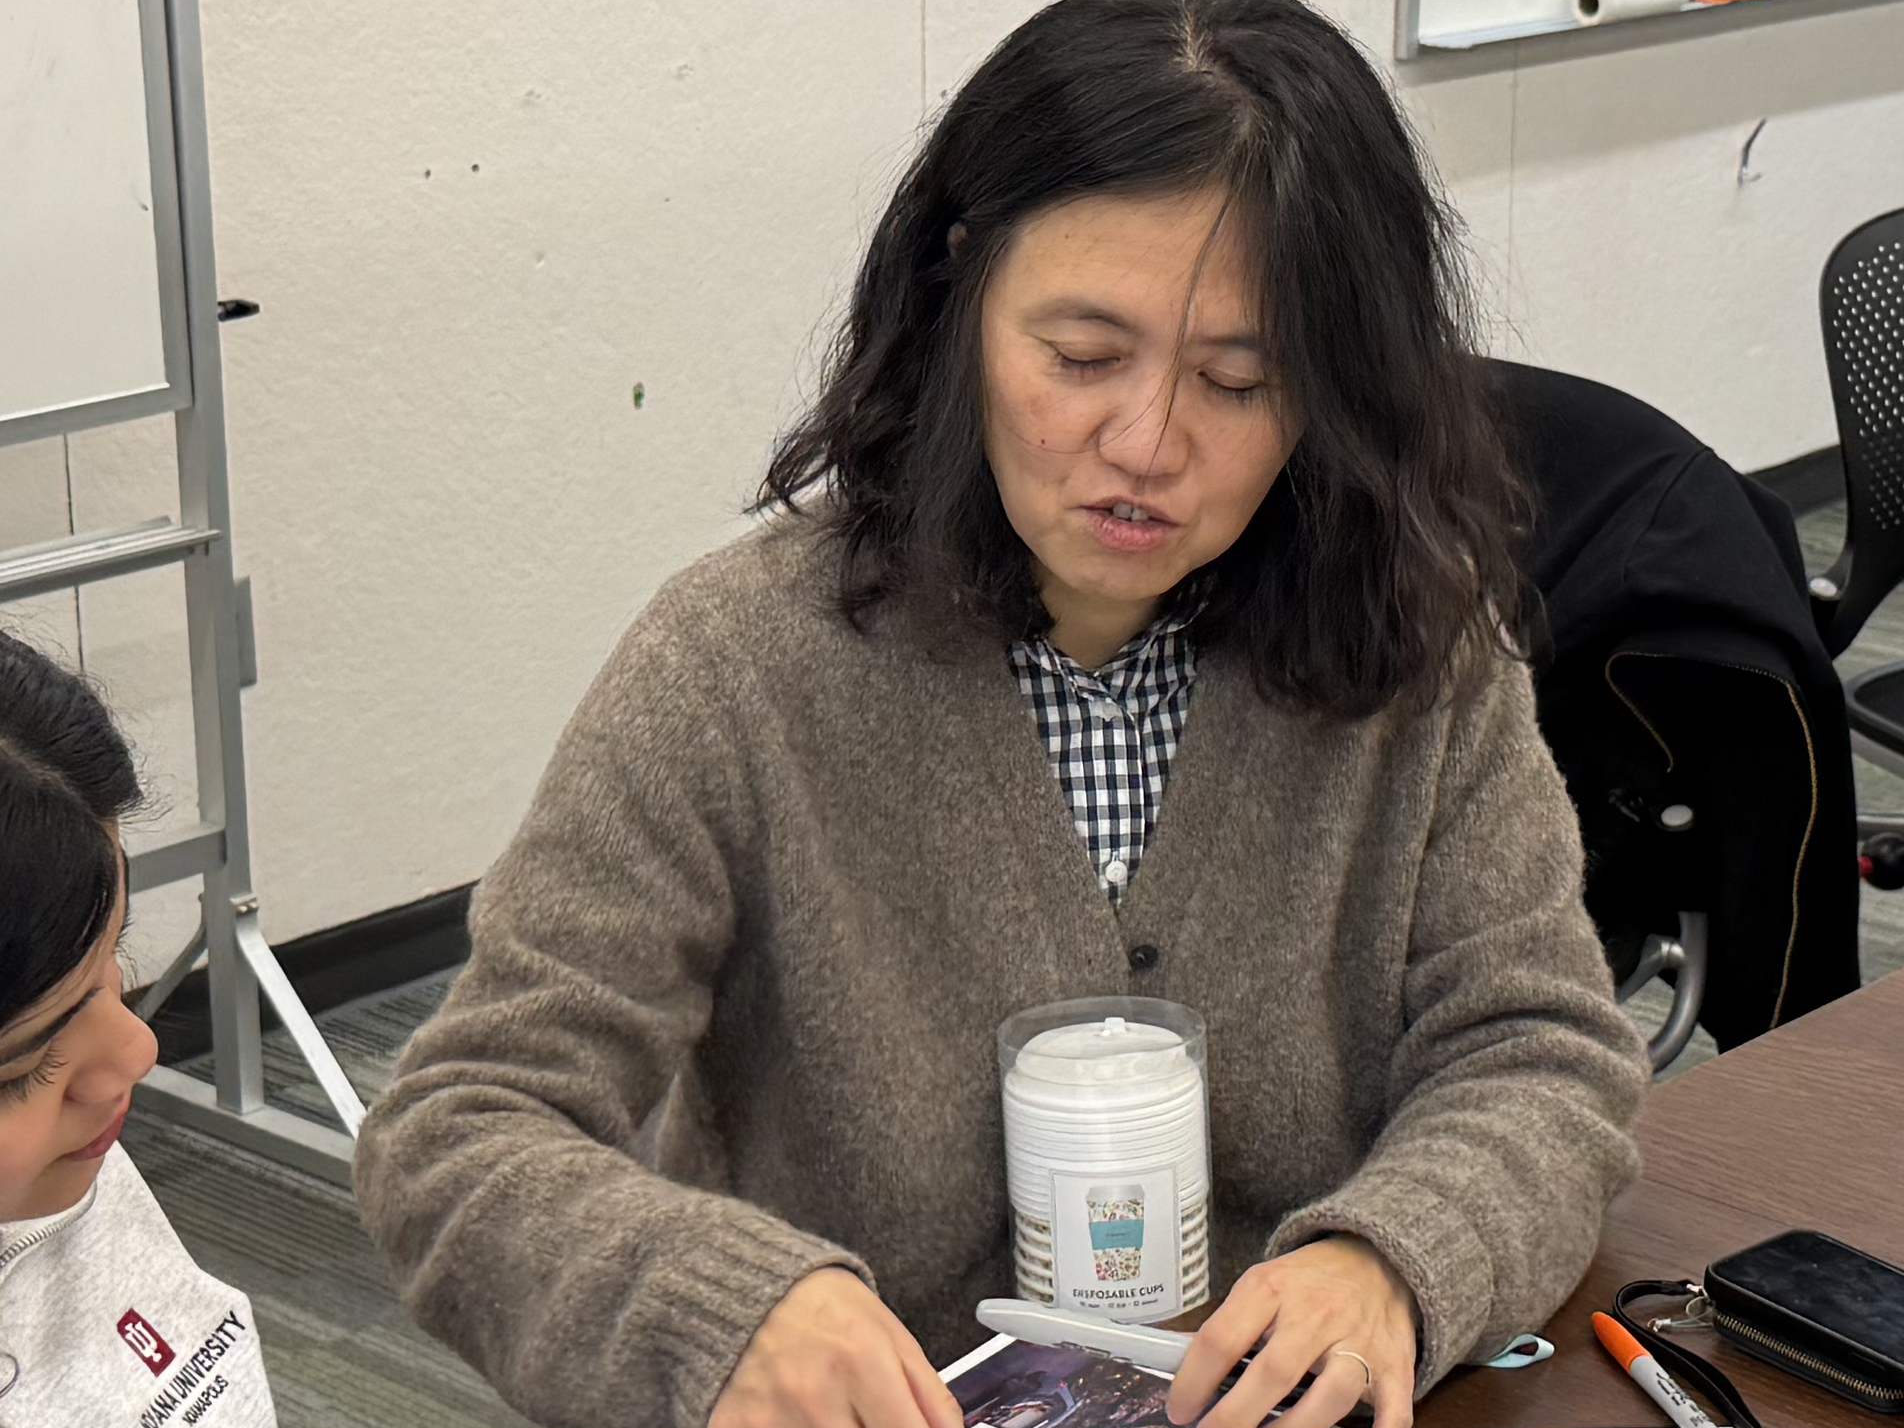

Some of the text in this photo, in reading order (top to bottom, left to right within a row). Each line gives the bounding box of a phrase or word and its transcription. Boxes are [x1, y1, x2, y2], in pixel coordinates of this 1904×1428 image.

[1073, 1284, 1164, 1299] DISPOSABLE CUPS
[177, 1310, 245, 1400] UNIVERSITY
